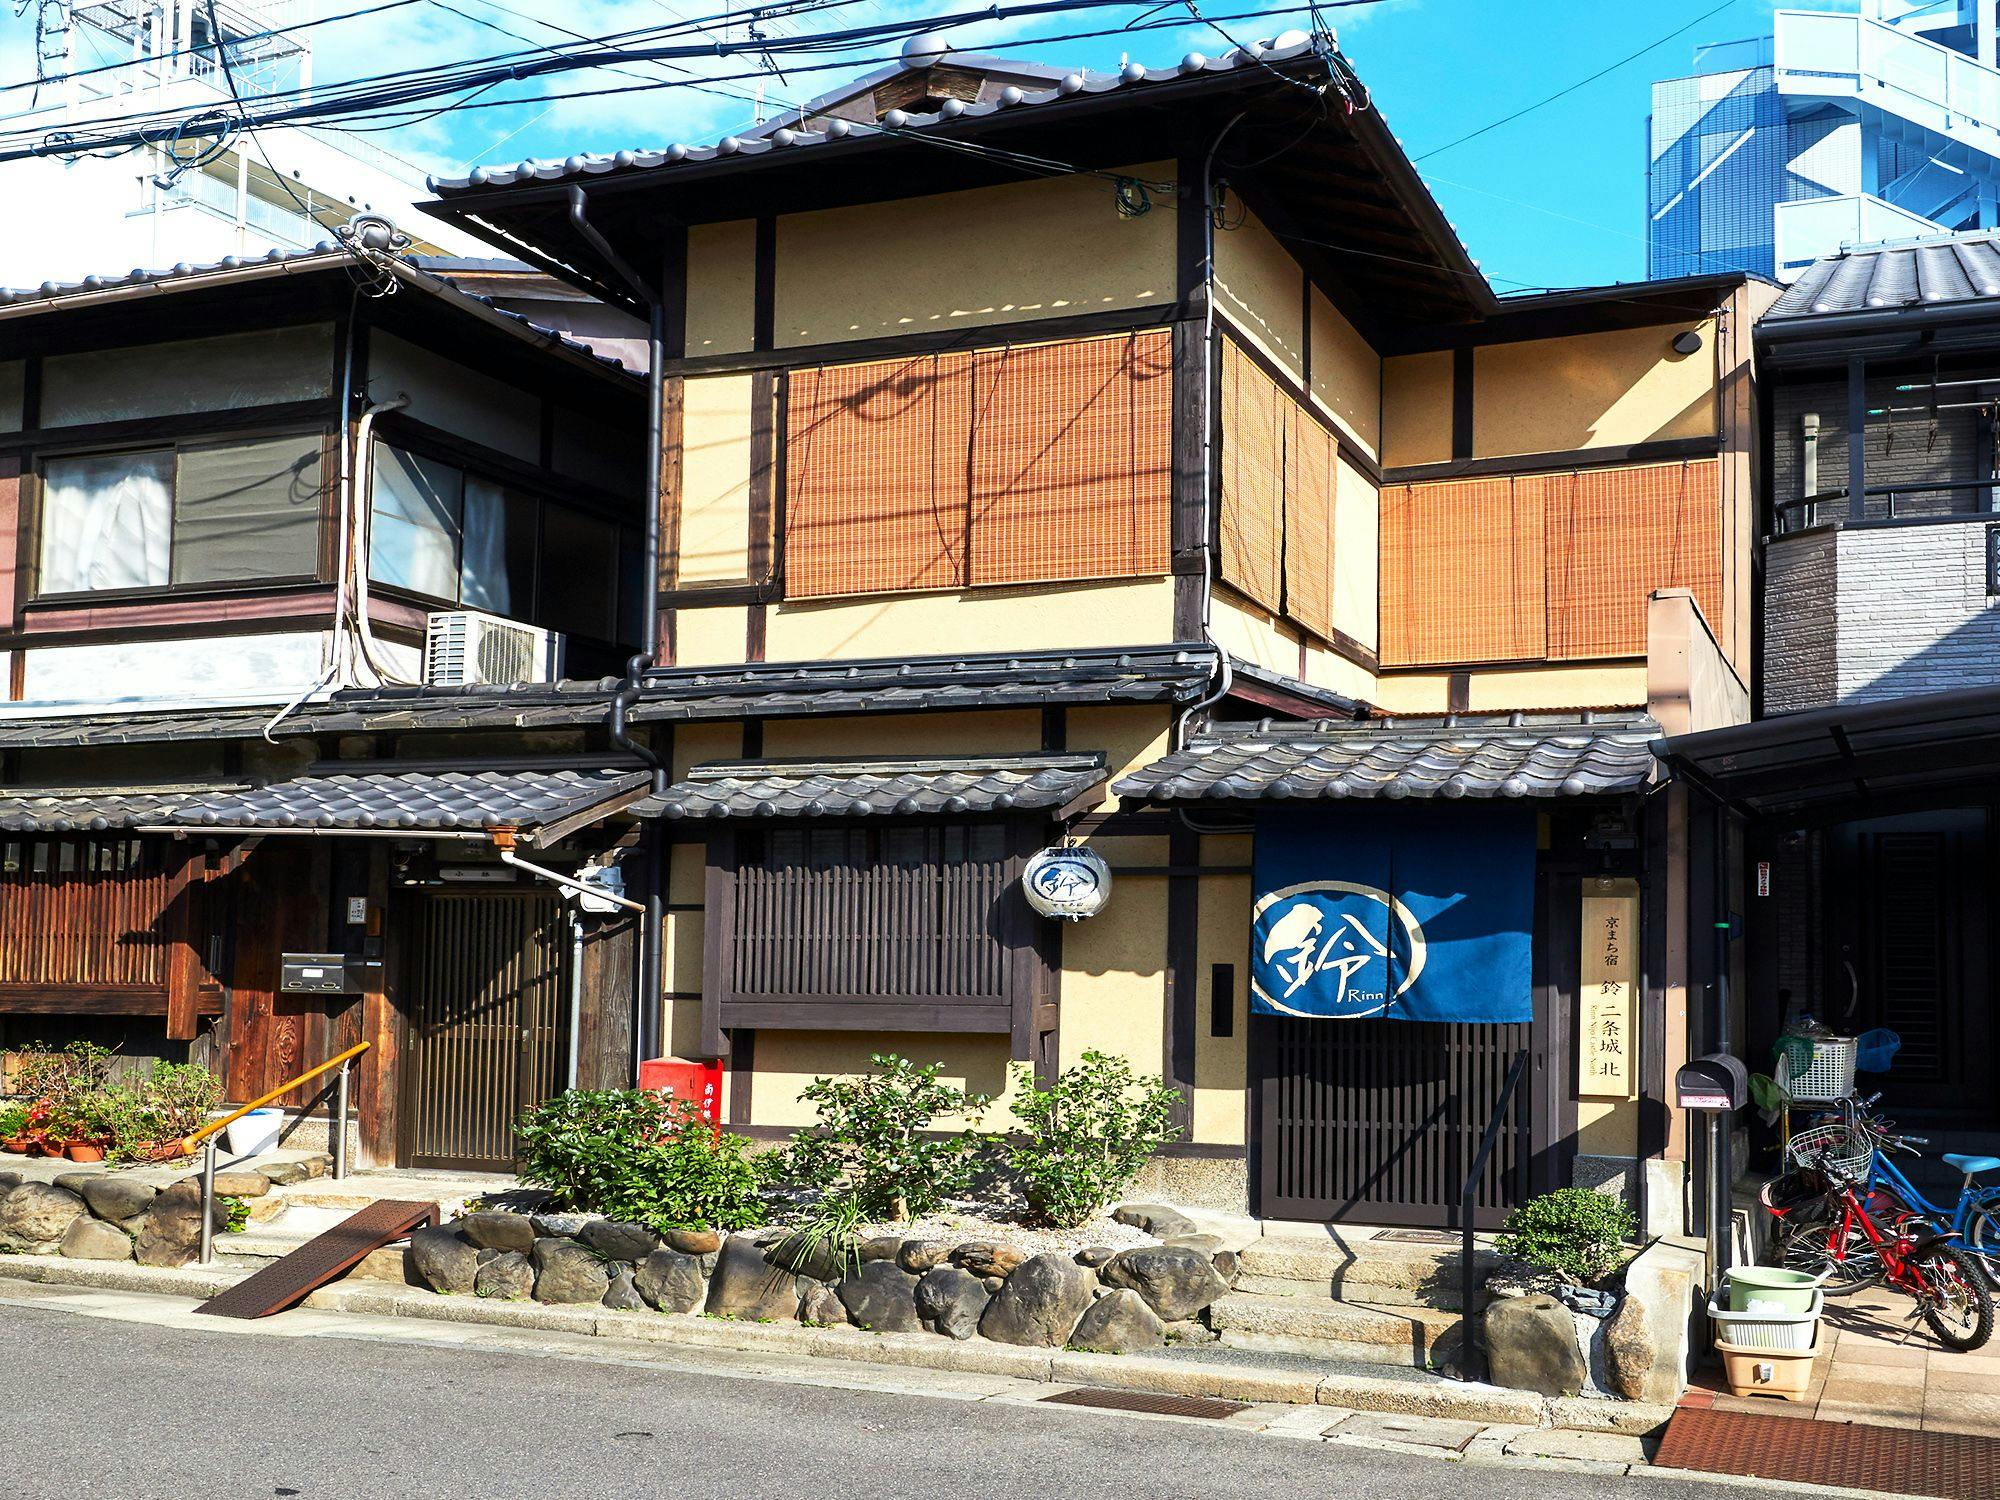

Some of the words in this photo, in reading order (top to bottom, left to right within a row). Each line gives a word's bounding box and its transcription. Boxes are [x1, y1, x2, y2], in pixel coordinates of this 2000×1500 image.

[1604, 916, 1620, 966] 京まち宿
[1347, 989, 1384, 1003] Rinn
[1600, 980, 1622, 996] 鈴
